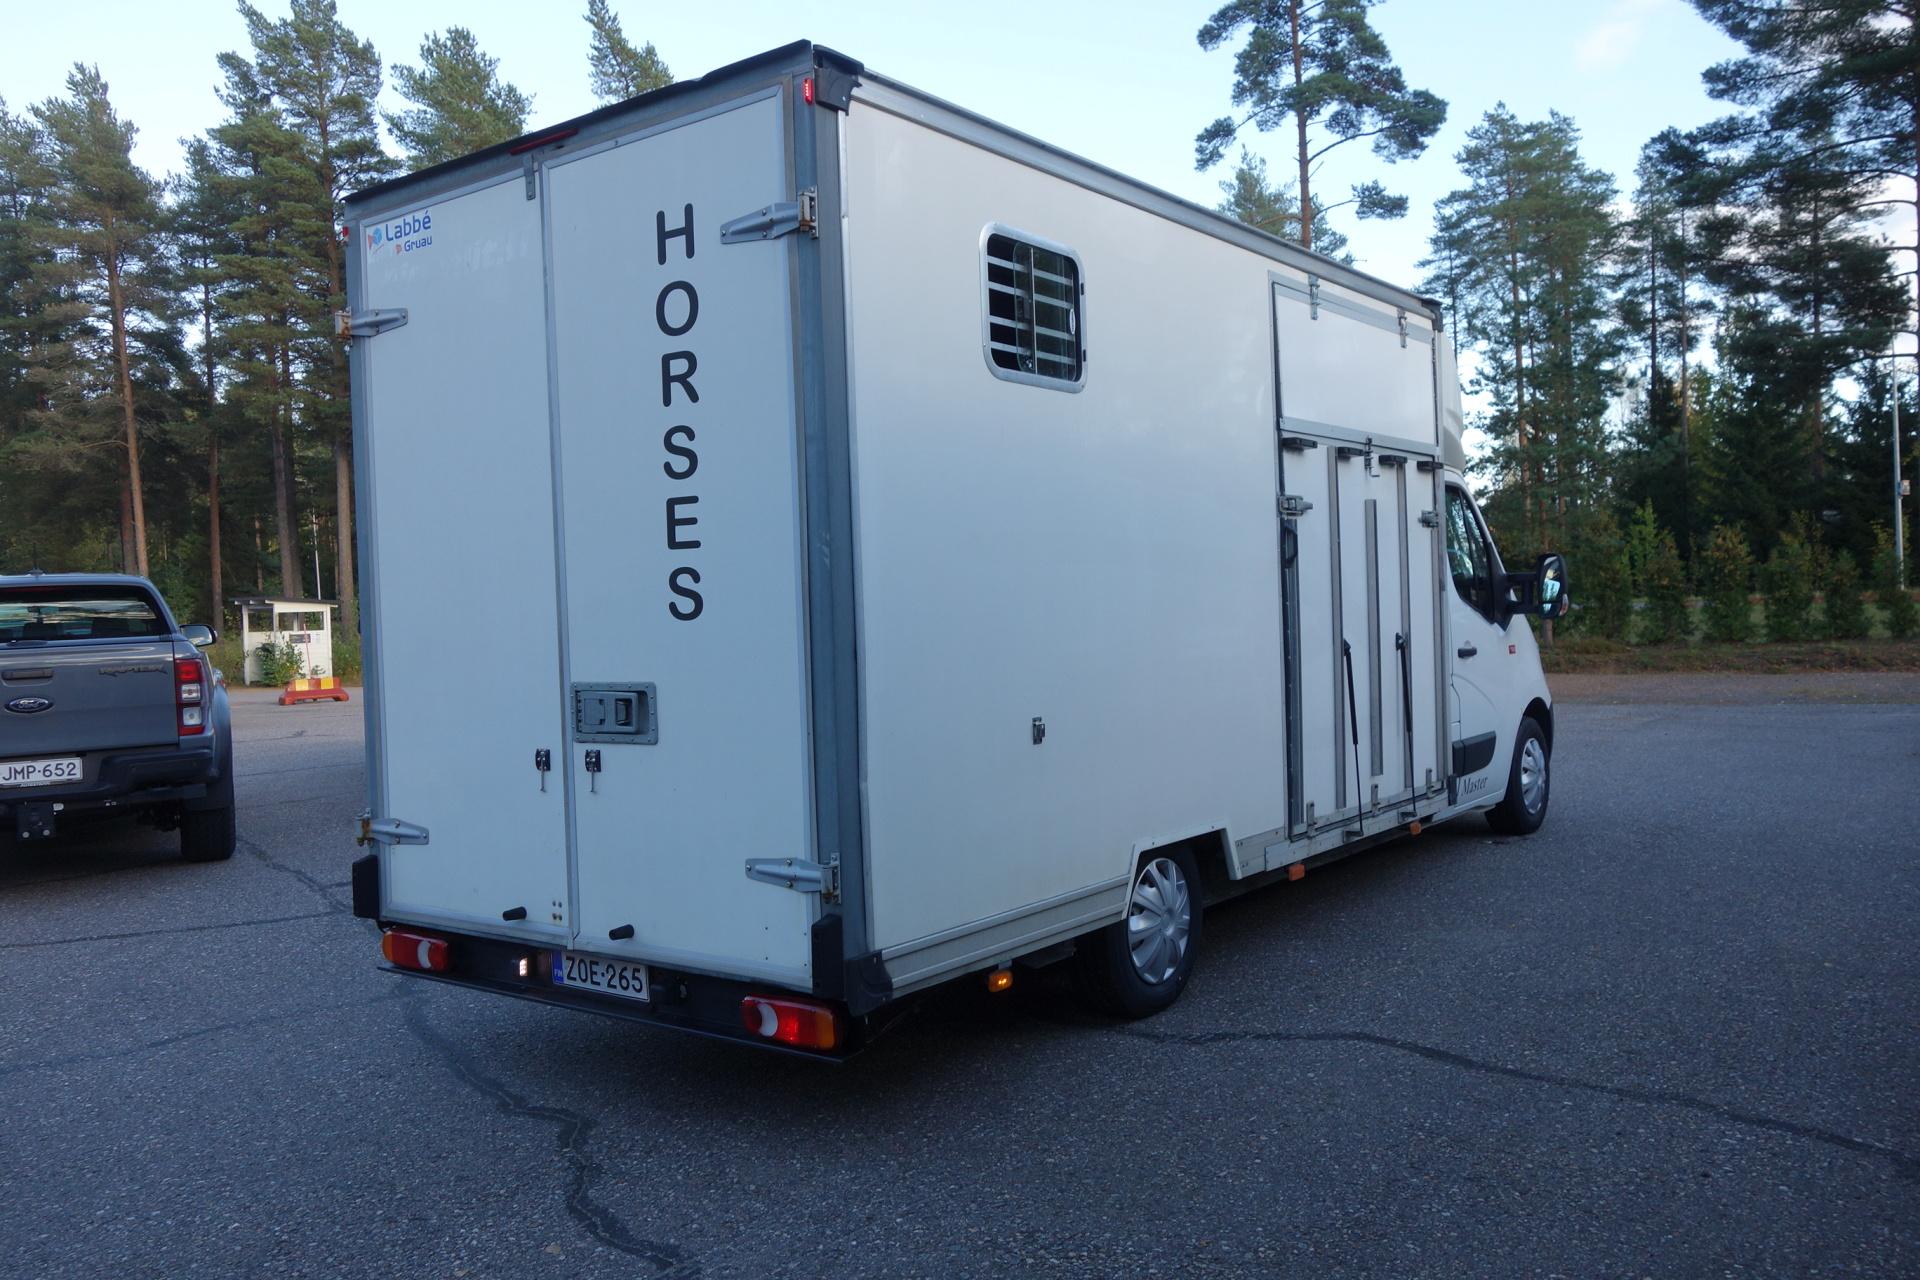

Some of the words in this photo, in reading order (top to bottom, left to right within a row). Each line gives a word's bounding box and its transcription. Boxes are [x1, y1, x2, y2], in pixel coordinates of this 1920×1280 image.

[385, 209, 432, 242] Labbé
[404, 235, 433, 252] Gruau
[656, 203, 704, 621] HORSES
[1461, 776, 1488, 796] Master
